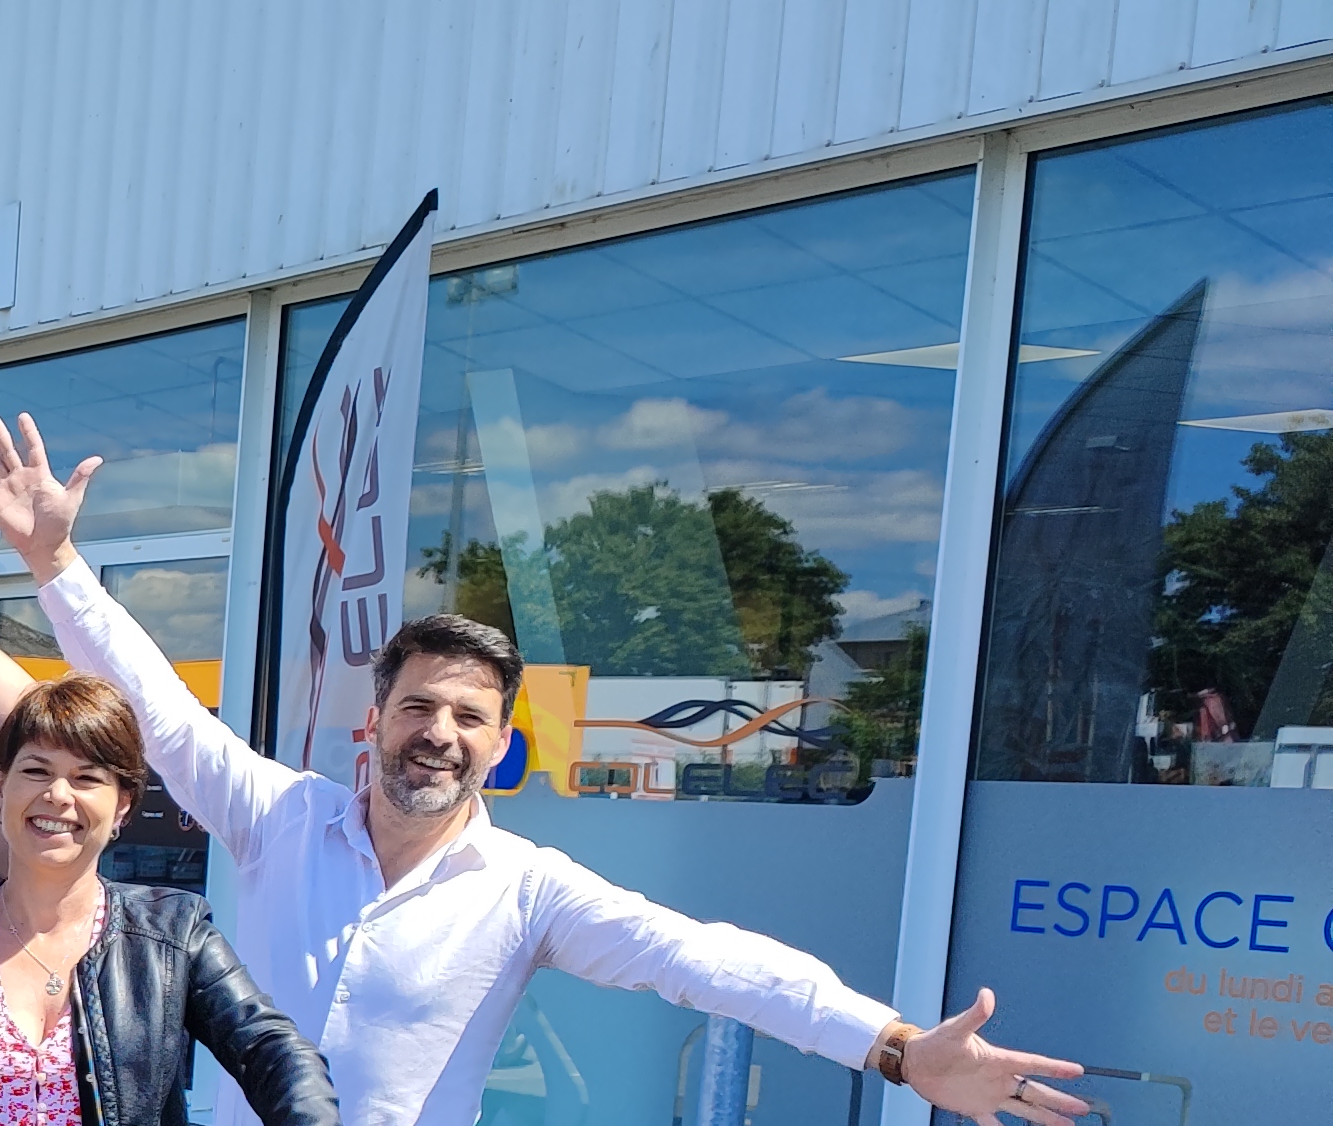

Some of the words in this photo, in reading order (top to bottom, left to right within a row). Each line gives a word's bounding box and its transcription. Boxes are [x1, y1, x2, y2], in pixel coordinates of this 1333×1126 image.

[1010, 879, 1295, 953] ESPACE
[1164, 966, 1207, 995] du
[1219, 968, 1304, 1004] lundi
[1203, 1008, 1238, 1035] et
[1249, 1008, 1279, 1039] le
